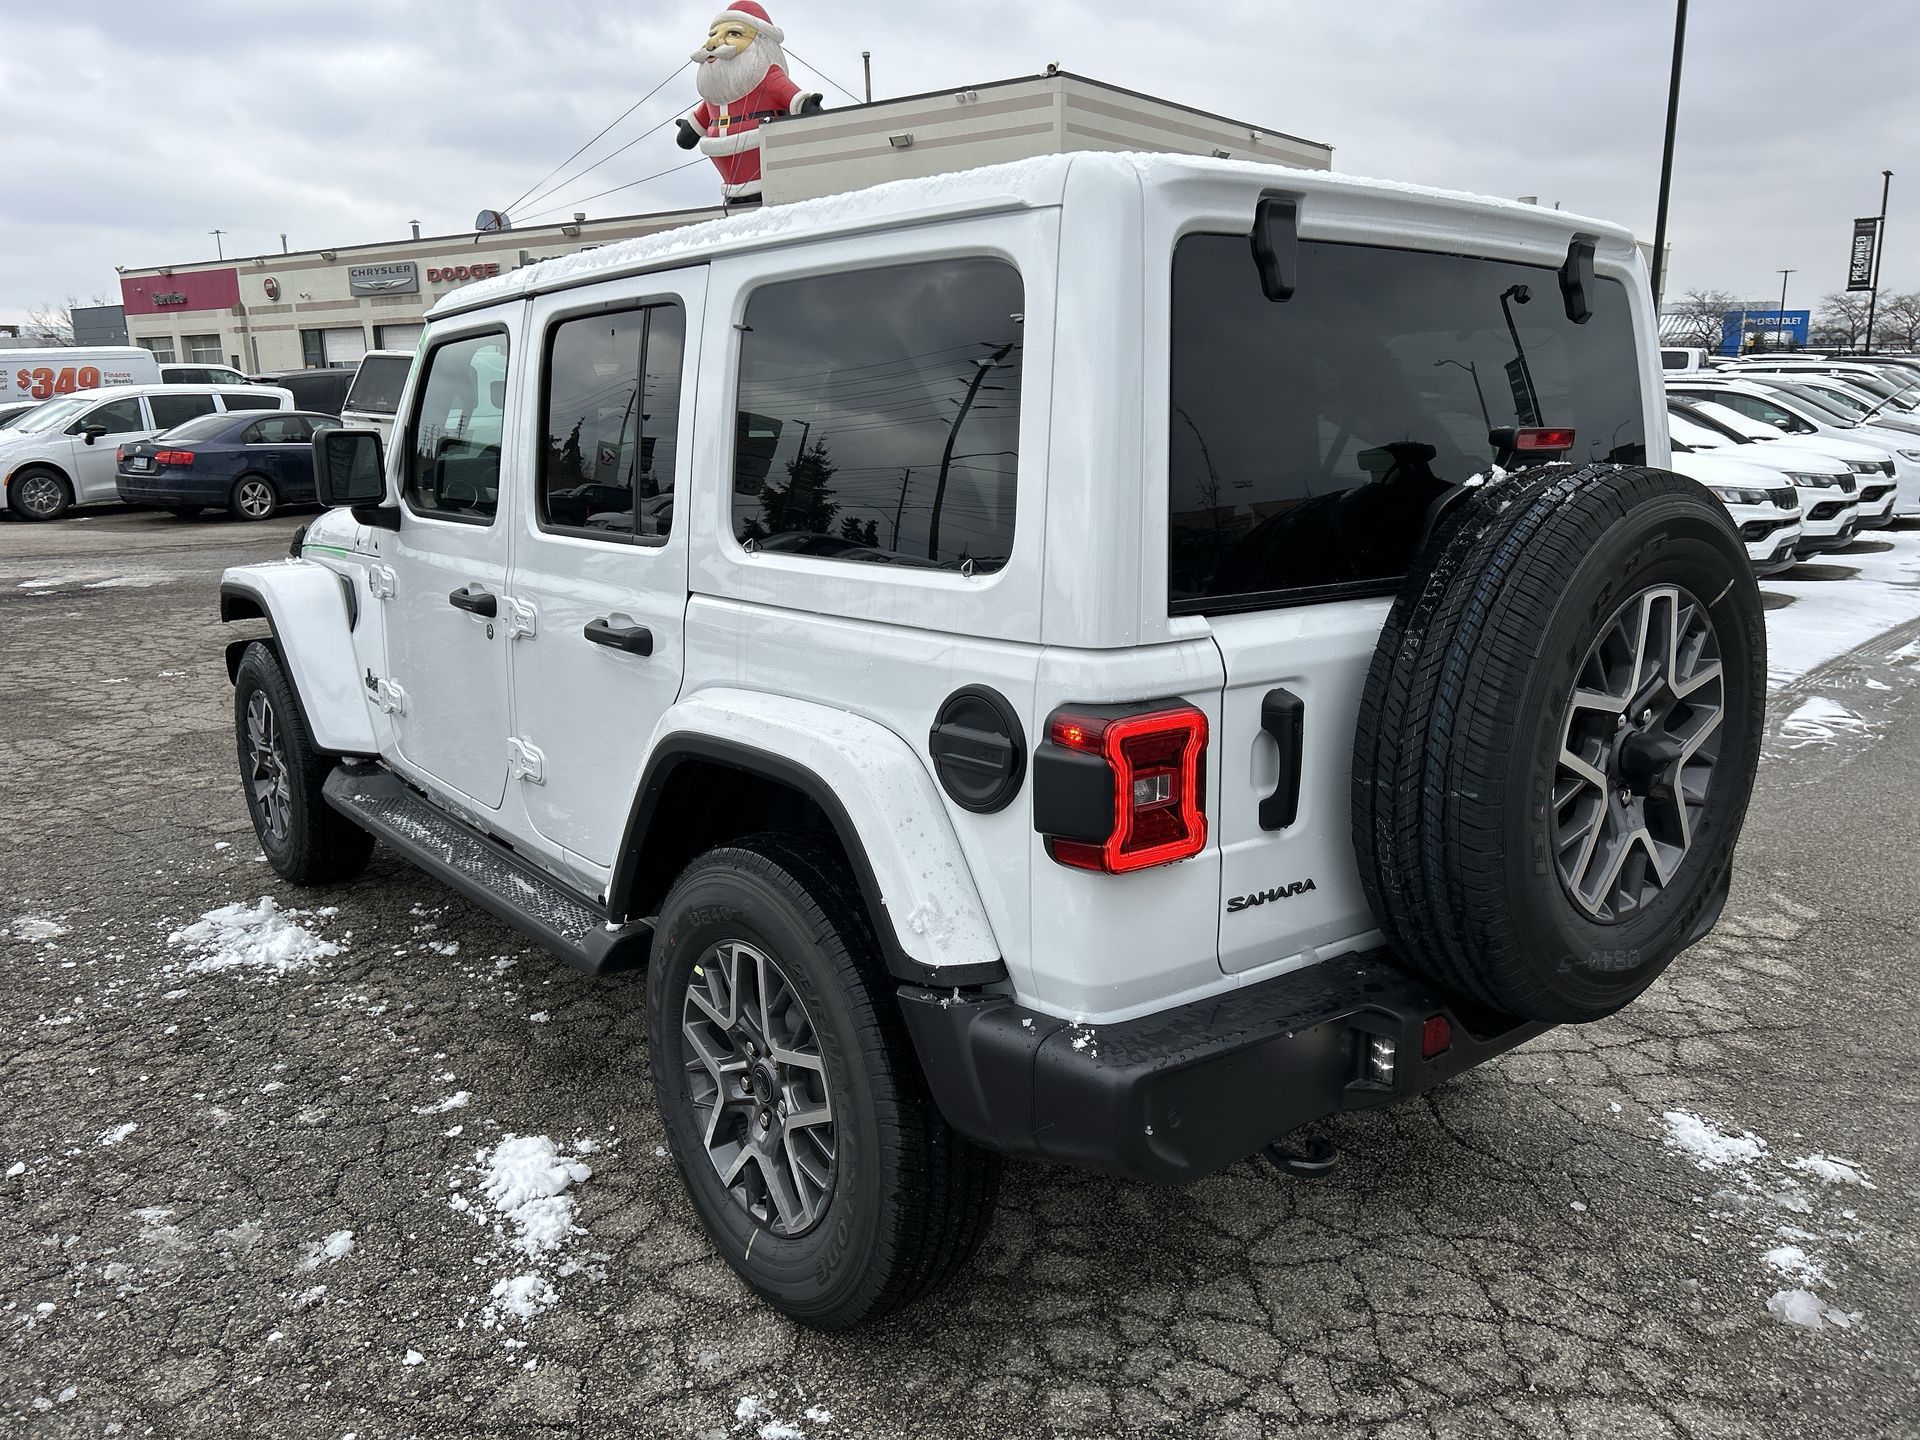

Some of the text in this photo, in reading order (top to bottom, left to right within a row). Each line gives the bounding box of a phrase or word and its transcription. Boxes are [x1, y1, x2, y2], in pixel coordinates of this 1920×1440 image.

[351, 264, 412, 277] CHRYSLER
[1851, 235, 1867, 281] PRE-OWNED
[427, 263, 500, 283] DODGE
[151, 291, 185, 305] Service
[16, 366, 101, 400] $349
[1226, 878, 1317, 913] SAHARA
